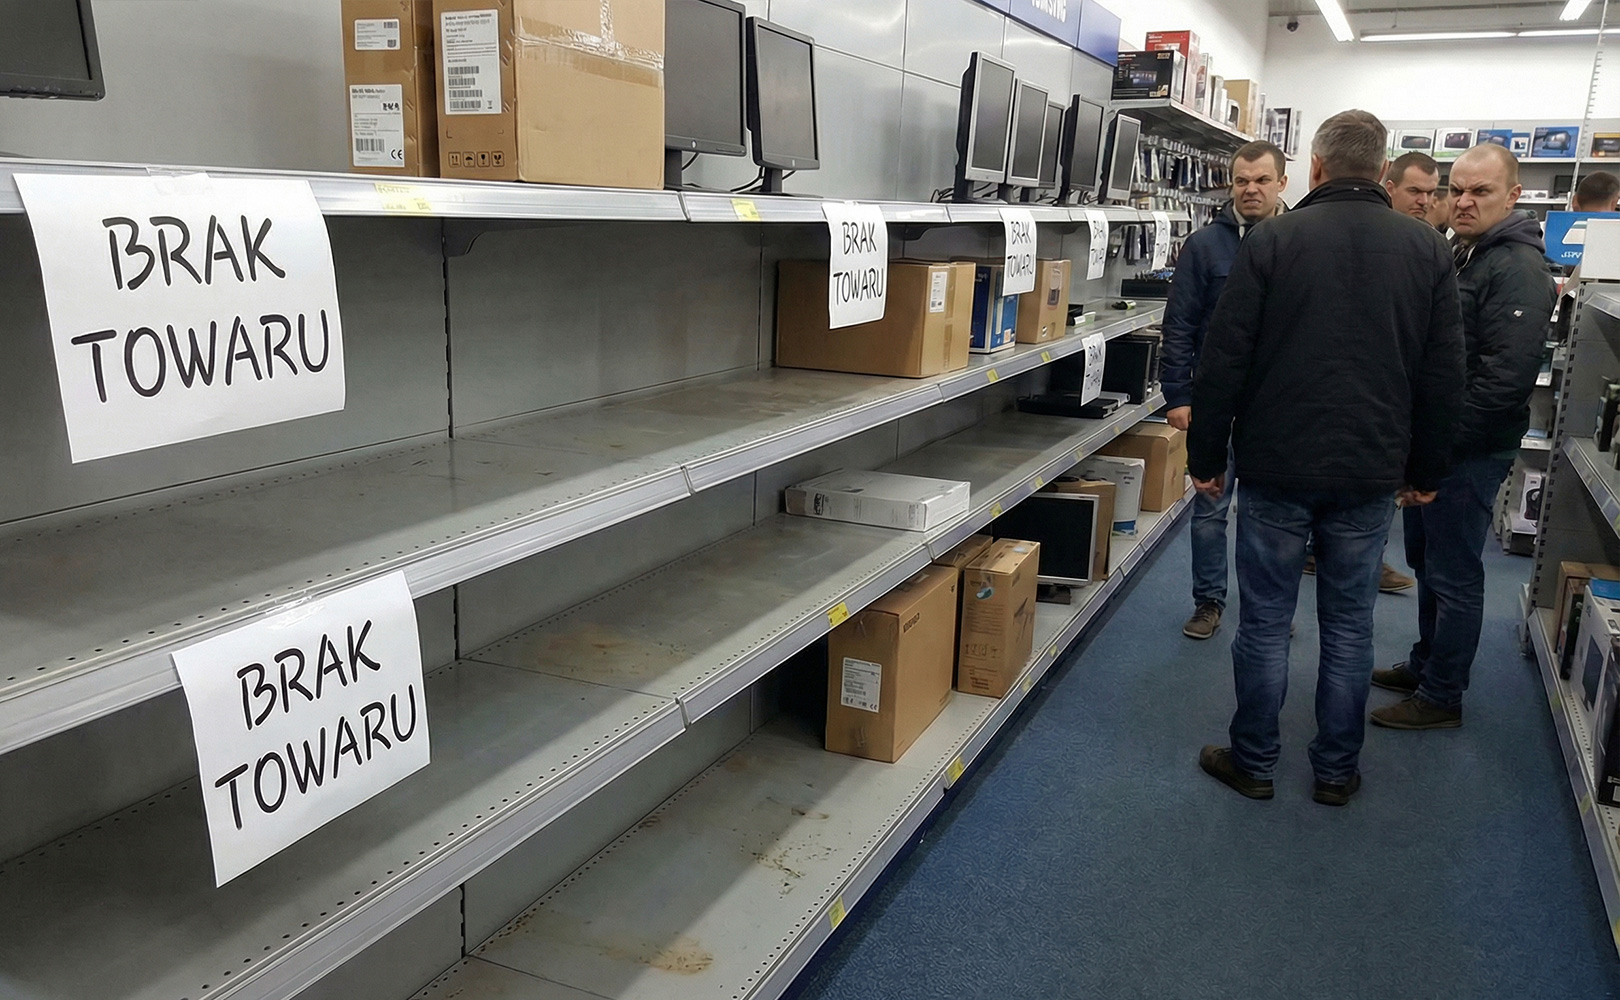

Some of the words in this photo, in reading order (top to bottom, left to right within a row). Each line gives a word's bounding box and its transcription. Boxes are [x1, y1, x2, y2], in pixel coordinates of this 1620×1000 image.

[102, 215, 286, 290] BRAK
[841, 221, 877, 255] BRAK
[833, 267, 884, 305] TOWARU
[71, 309, 330, 403] TOWARU
[237, 619, 381, 730] BRAK
[214, 684, 416, 830] TOWARU
